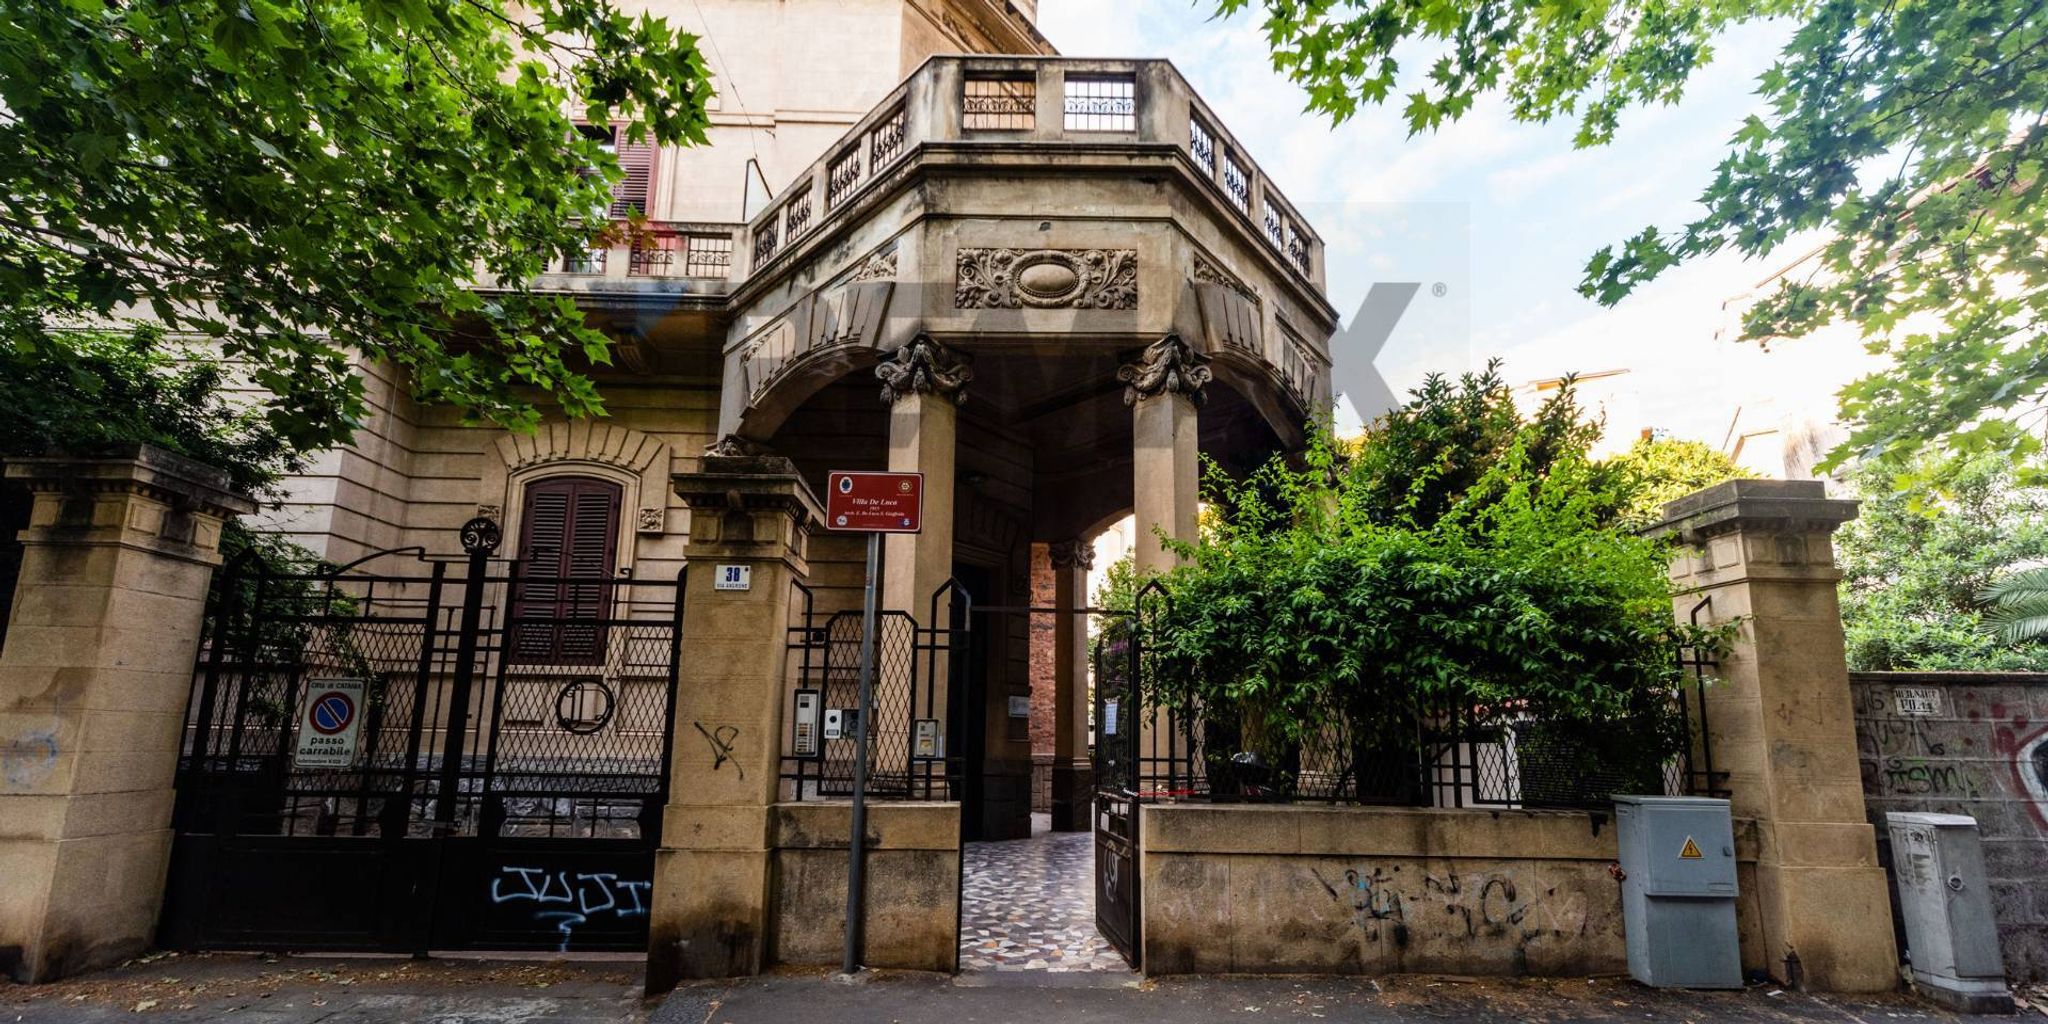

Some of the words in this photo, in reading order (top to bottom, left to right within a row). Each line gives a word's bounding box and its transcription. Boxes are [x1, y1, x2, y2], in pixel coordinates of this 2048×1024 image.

[726, 567, 740, 582] 38
[311, 737, 344, 746] passo
[300, 747, 351, 755] carrabile
